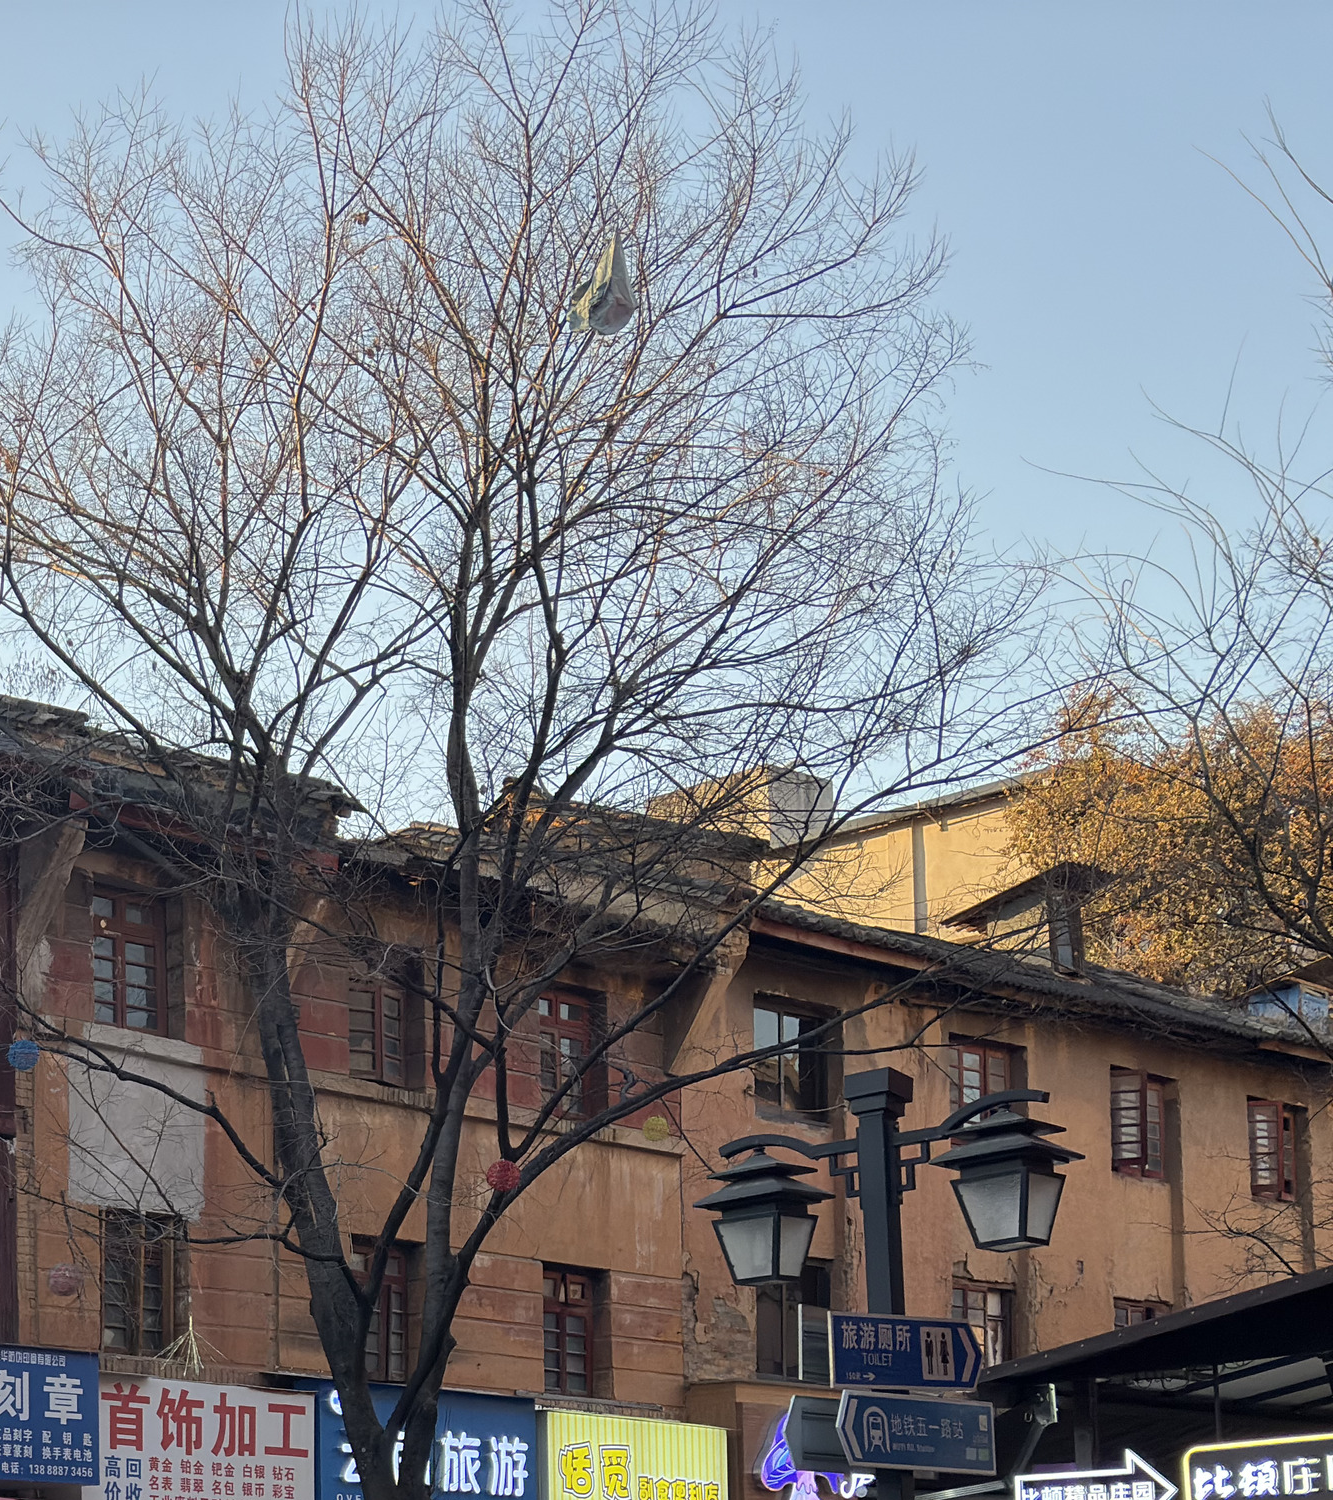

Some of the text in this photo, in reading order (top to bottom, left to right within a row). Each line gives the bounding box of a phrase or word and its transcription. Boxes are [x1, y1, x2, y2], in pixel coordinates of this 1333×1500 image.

[841, 1321, 911, 1351] 旅游厕所
[862, 1352, 893, 1367] TOILET
[101, 1382, 309, 1458] 首饰加工
[891, 1414, 964, 1439] 地铁五一路站
[42, 1446, 93, 1462] 换手表电池
[148, 1456, 295, 1482] 黄金 铂金 钯金 白银 钻石
[560, 1443, 631, 1500] 恬觅
[1194, 1457, 1333, 1500] 比顿庄
[149, 1475, 295, 1500] 名表 翡翠 名包 银币 彩宝
